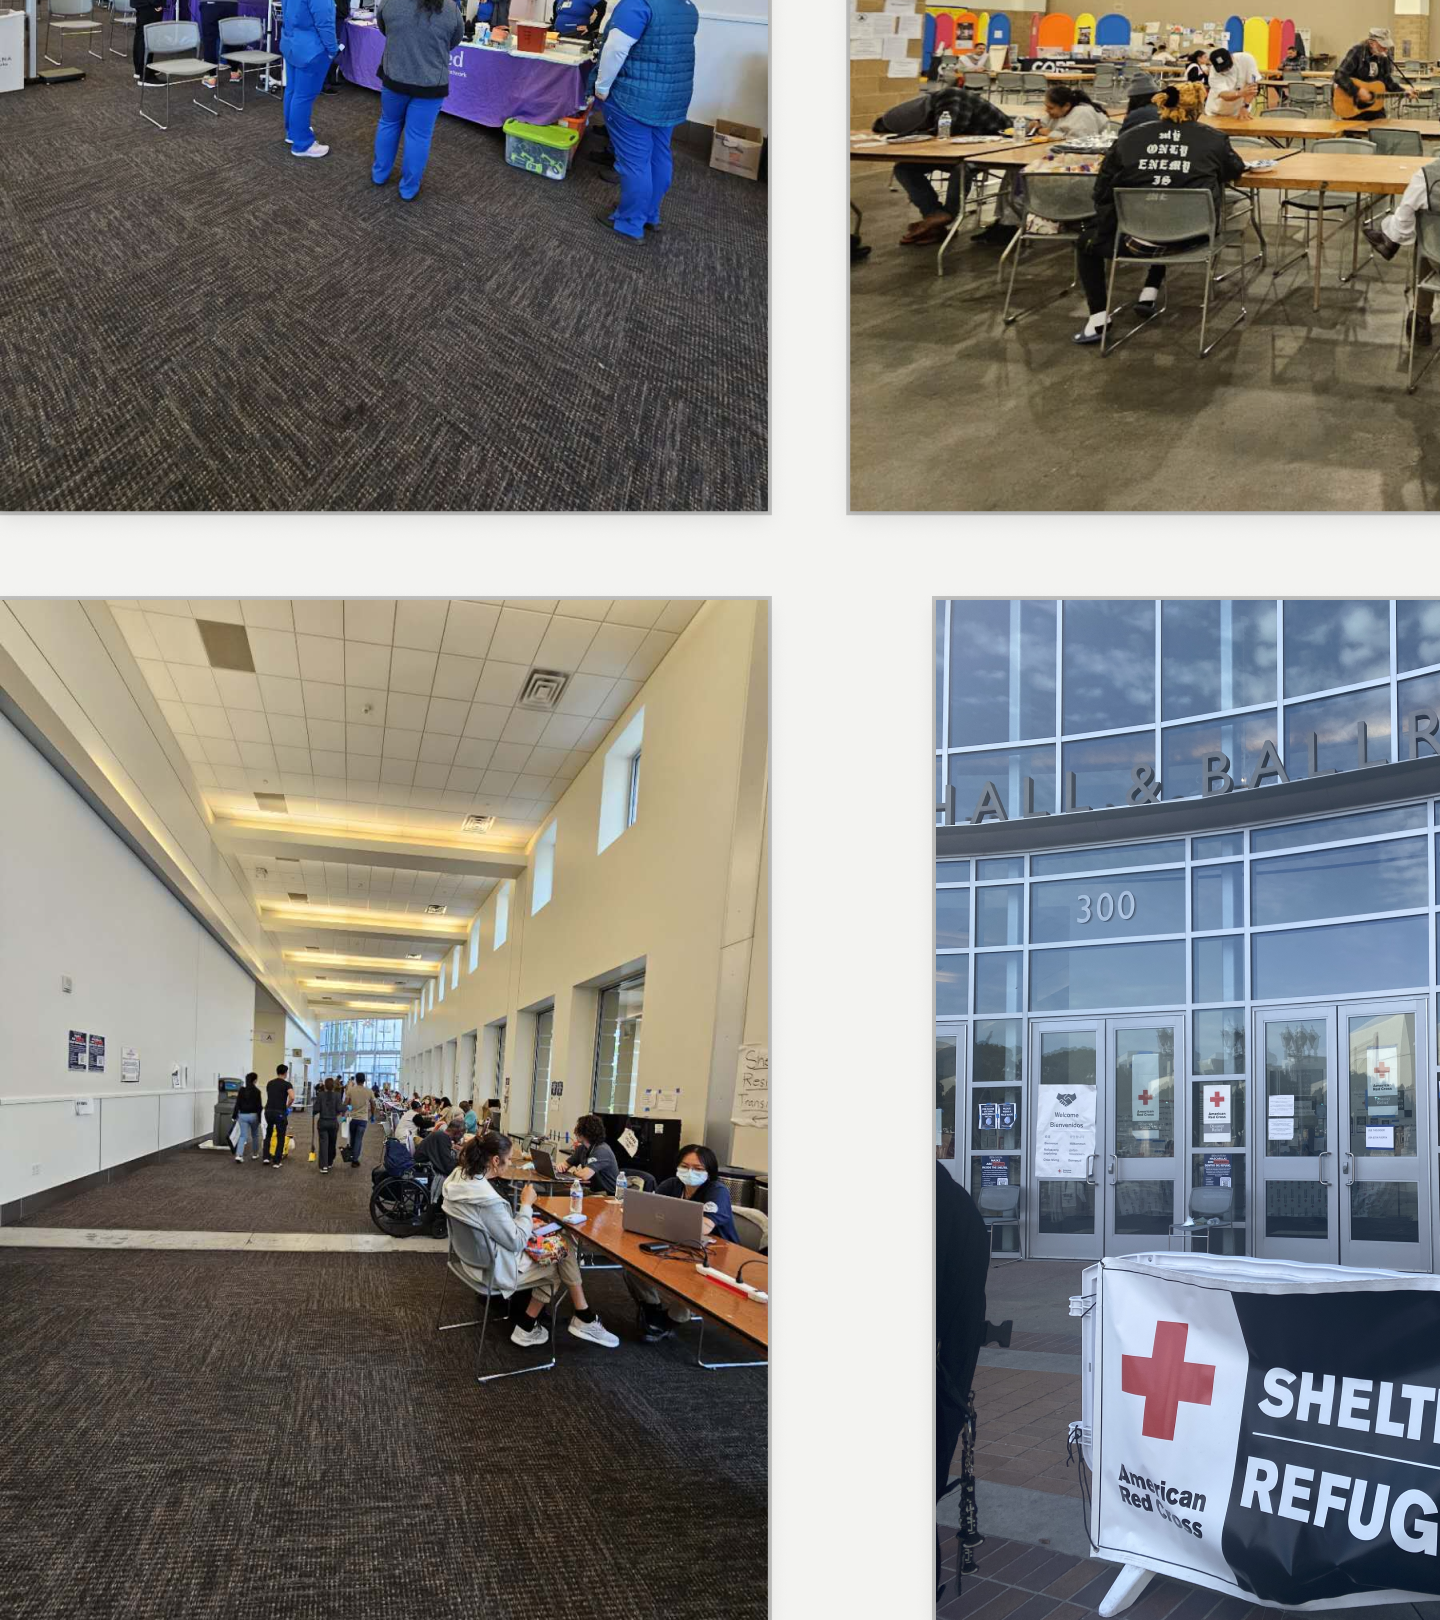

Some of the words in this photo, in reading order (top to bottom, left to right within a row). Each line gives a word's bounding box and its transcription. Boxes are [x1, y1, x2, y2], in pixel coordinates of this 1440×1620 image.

[1128, 764, 1163, 805] &
[1075, 890, 1137, 925] 300
[1049, 1121, 1084, 1129] Bienvenidos
[1054, 1111, 1080, 1119] Welcome
[1117, 1463, 1208, 1513] American
[1119, 1484, 1154, 1513] Red
[1155, 1498, 1203, 1539] Cross
